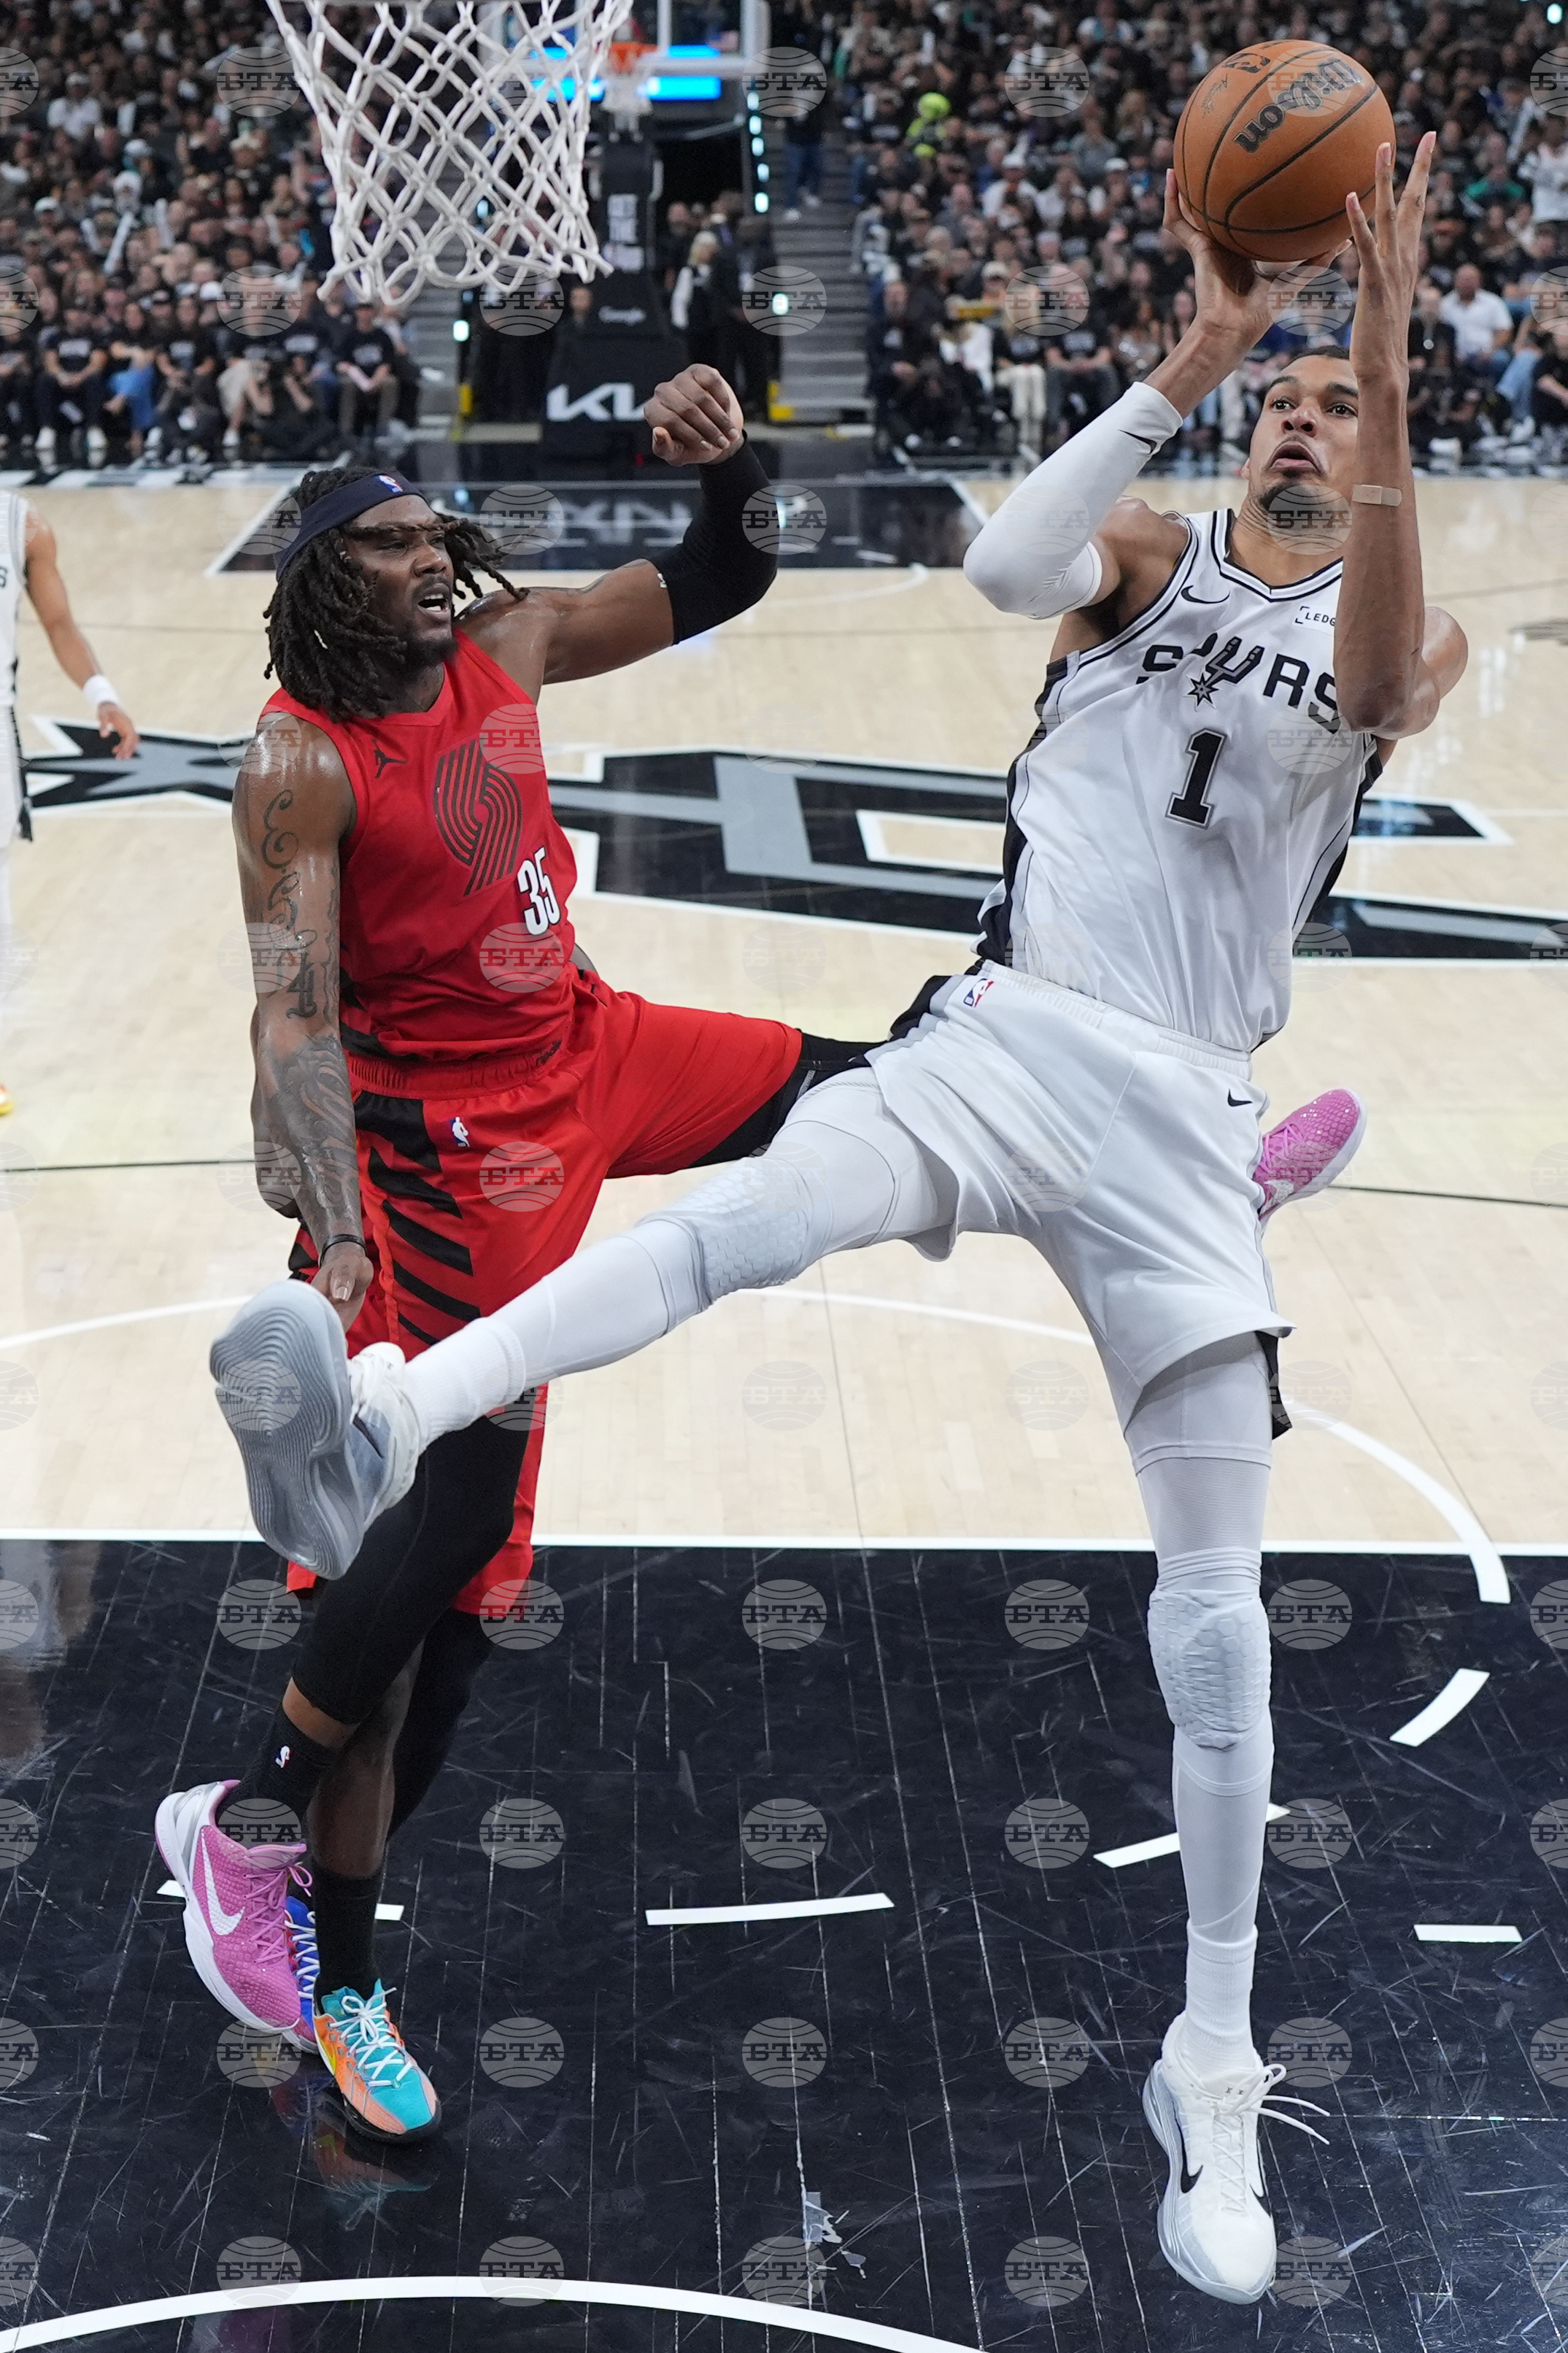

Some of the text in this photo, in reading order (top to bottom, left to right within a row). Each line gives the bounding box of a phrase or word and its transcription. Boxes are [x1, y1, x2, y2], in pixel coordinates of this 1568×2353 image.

[547, 382, 647, 422] KI
[1165, 728, 1227, 830] 1
[517, 844, 561, 936] 35
